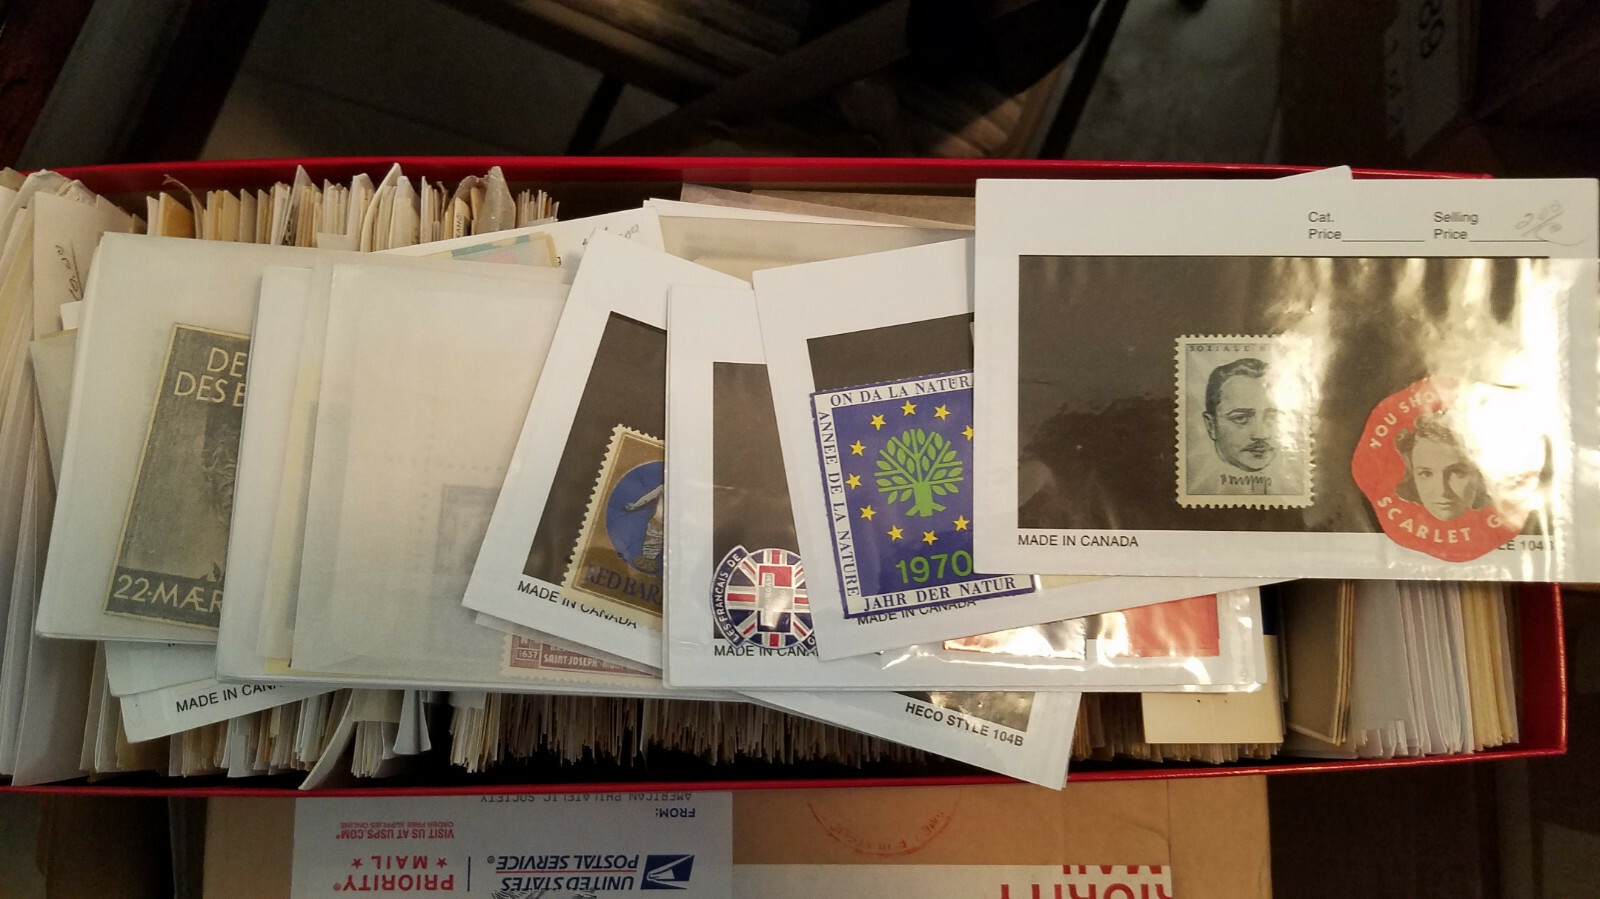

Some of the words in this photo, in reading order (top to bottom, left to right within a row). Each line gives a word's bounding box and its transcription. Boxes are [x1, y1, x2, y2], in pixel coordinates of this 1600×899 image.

[1308, 211, 1335, 223] Cat.
[1433, 211, 1479, 225] Selling
[1308, 228, 1342, 239] Price
[1433, 228, 1468, 239] Price
[174, 371, 228, 403] DES
[831, 393, 853, 407] ON
[860, 390, 882, 403] DA
[888, 386, 909, 398] LA
[915, 375, 973, 394] NATÜR
[818, 411, 838, 465] ANNEE
[1369, 413, 1397, 449] YOU
[828, 472, 843, 495] DE
[833, 501, 847, 522] LA
[1377, 496, 1471, 544] SCARLET
[1018, 535, 1058, 546] MADE
[1062, 535, 1076, 546] IN
[1080, 535, 1139, 547] CANADA
[726, 553, 742, 568] DE
[837, 531, 860, 596] NATURE
[896, 550, 973, 584] 1970
[584, 564, 621, 590] RED
[518, 580, 560, 603] MADE
[562, 597, 577, 609] IN
[864, 593, 907, 612] JAHR
[916, 588, 951, 603] DER
[960, 576, 1016, 596] NATUR
[902, 608, 915, 619] IN
[723, 623, 740, 643] LES
[714, 645, 754, 657] MADE
[759, 647, 772, 657] IN
[175, 692, 219, 712] MADE
[223, 687, 238, 701] IN
[905, 702, 943, 722] HECO
[946, 713, 989, 737] STYLE
[993, 727, 1025, 747] 104B
[655, 808, 696, 818] FROM:
[396, 828, 409, 839] AT
[411, 828, 426, 839] US
[428, 828, 455, 839] VISIT
[371, 855, 428, 869] MAIL
[576, 854, 640, 869] POSTAL
[343, 874, 455, 891] PRIORITY
[500, 876, 563, 892] STATES
[566, 876, 635, 890] UNITED
